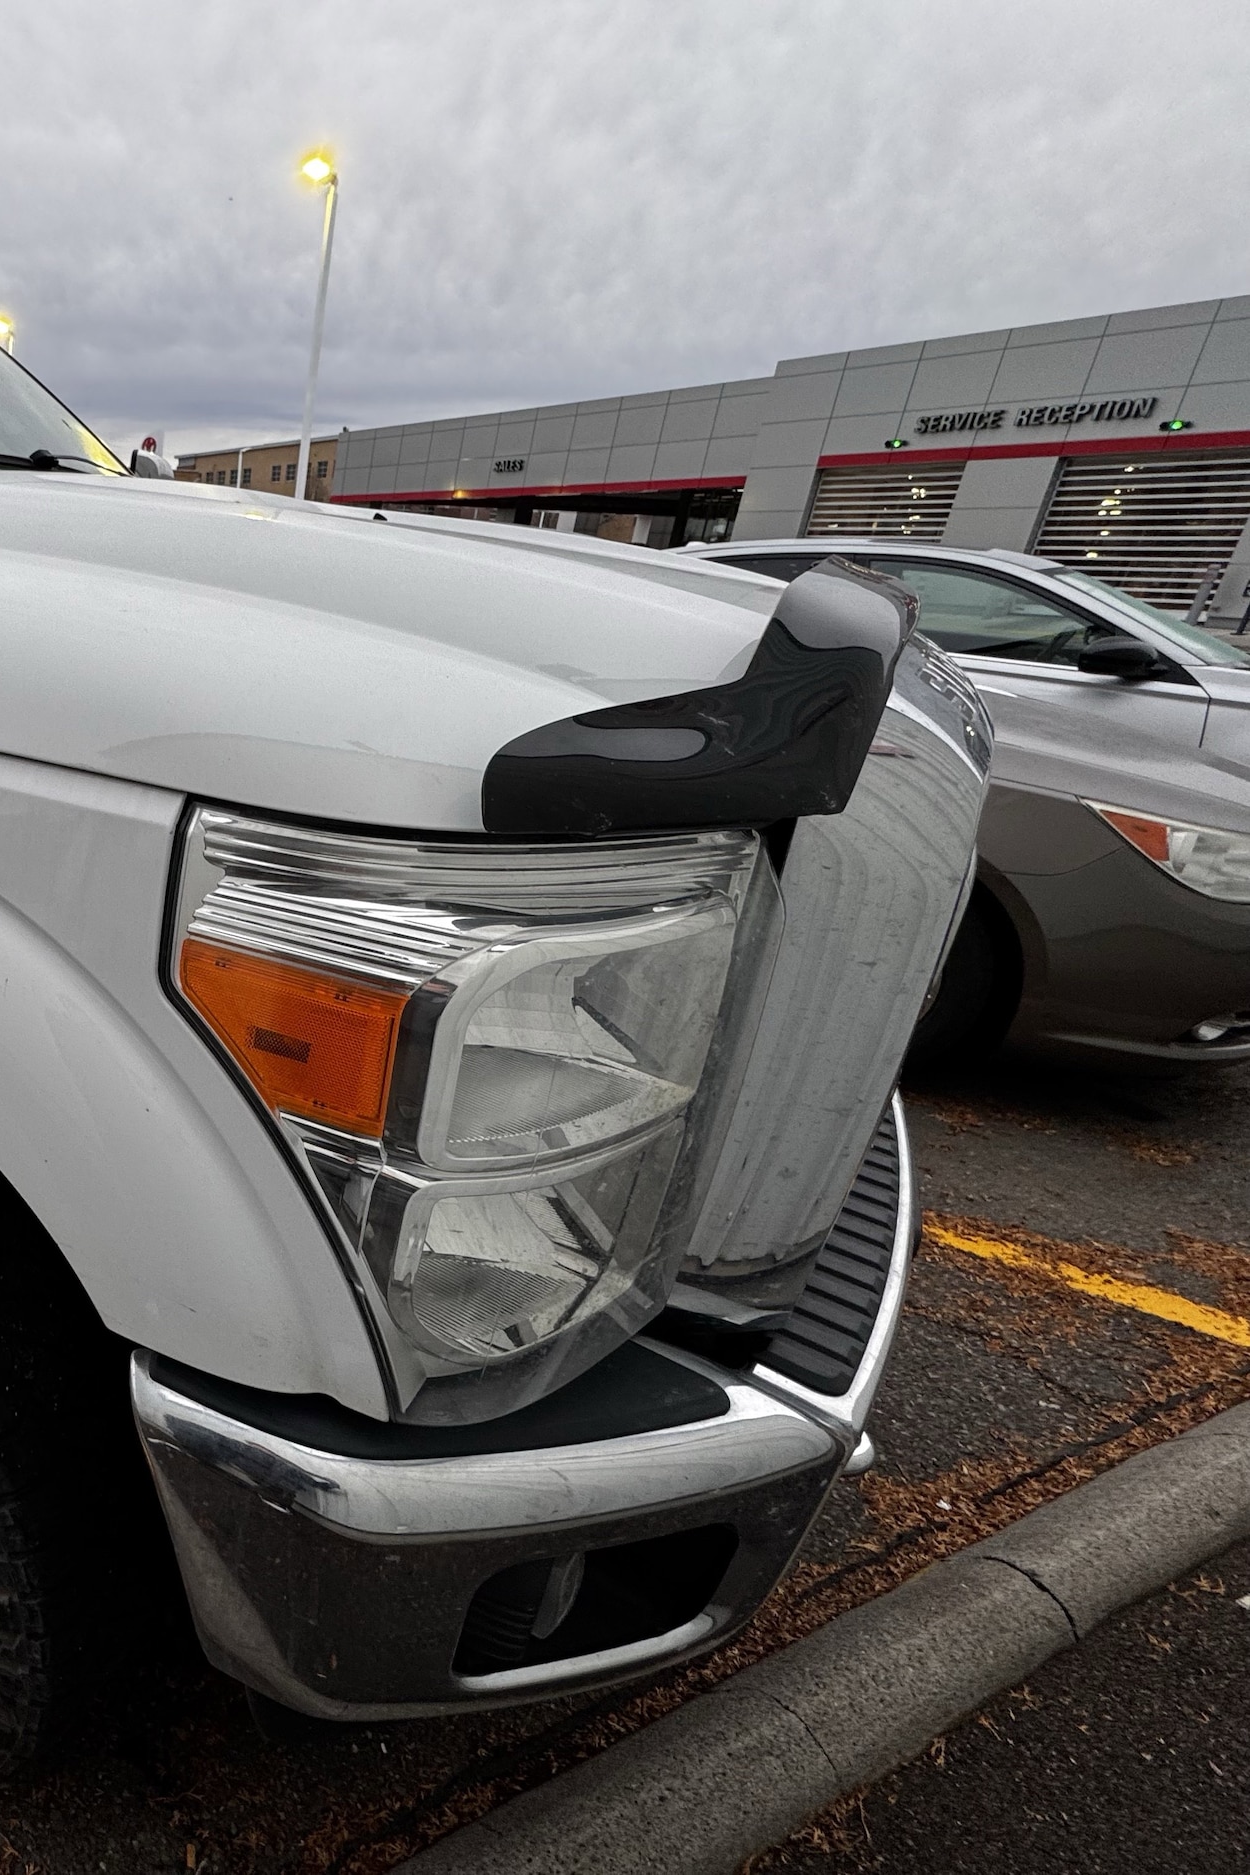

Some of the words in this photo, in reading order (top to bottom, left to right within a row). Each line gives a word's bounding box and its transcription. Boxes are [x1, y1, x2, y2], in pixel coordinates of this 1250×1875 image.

[914, 409, 1005, 434] SERVICE
[1014, 397, 1158, 426] RECEPTION
[494, 459, 524, 473] SALES
